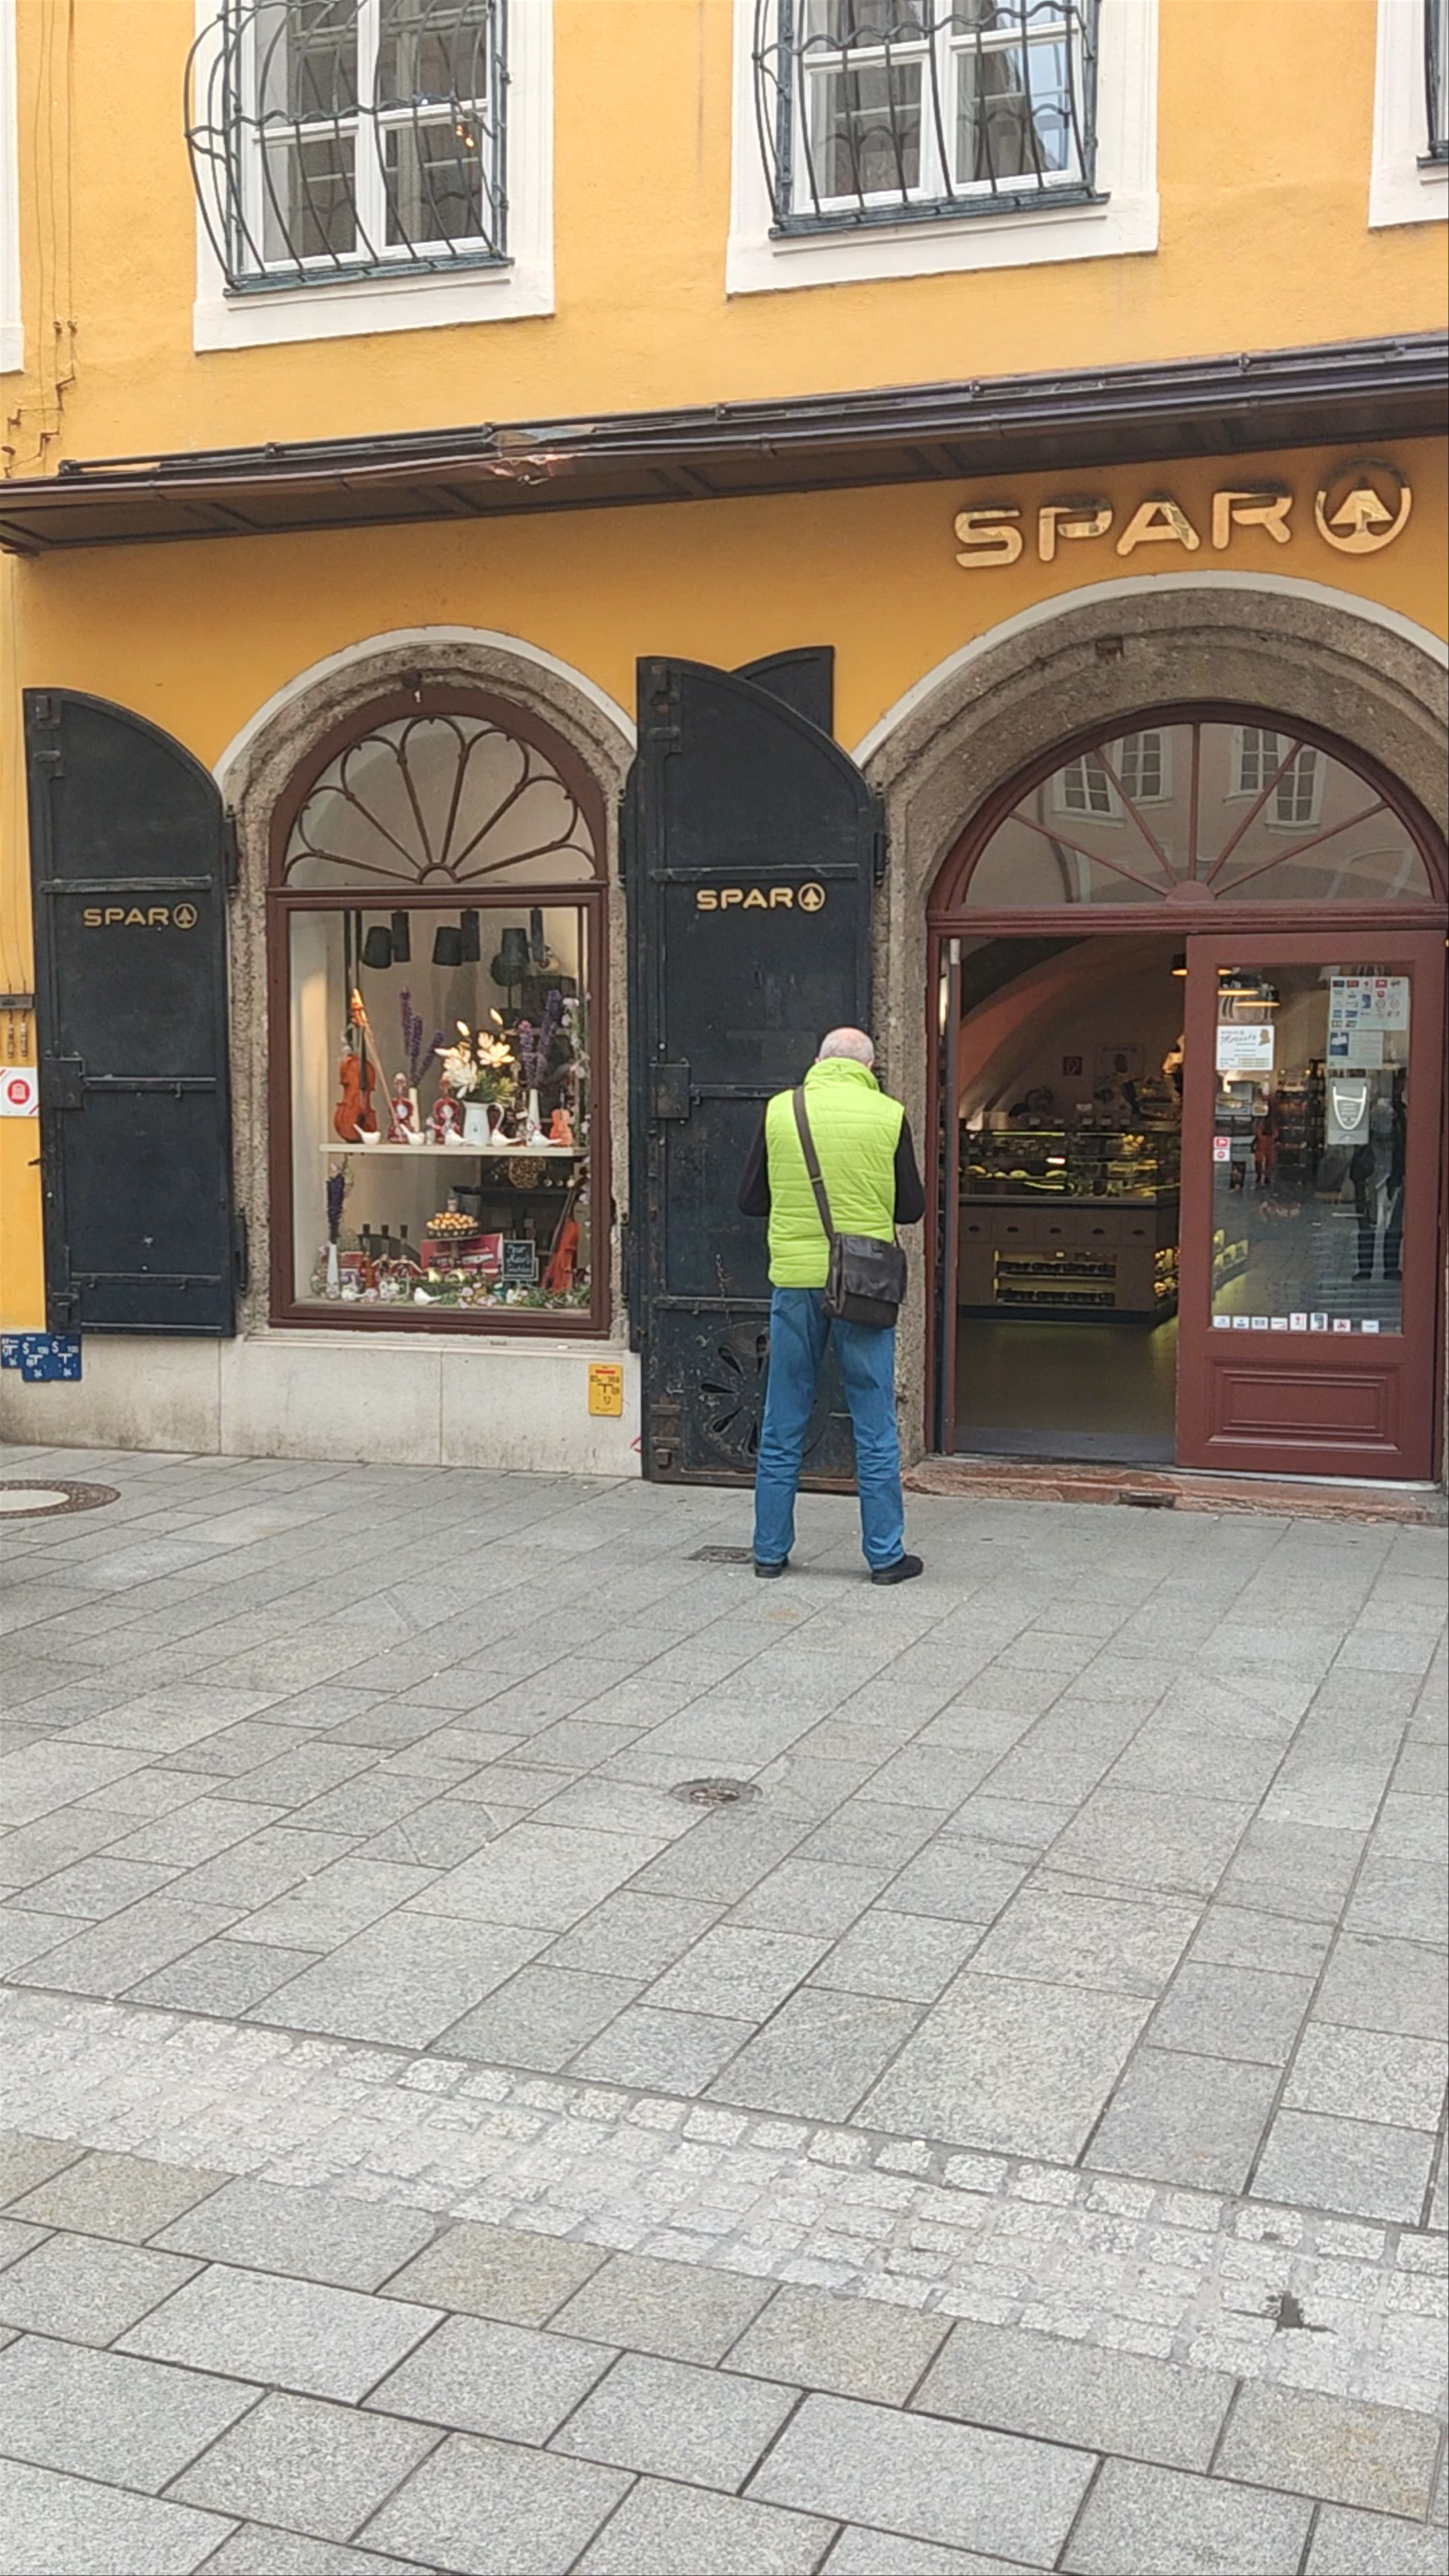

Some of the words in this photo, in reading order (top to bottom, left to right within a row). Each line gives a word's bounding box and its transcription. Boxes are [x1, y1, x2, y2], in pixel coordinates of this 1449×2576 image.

[954, 481, 1293, 568] SPAR
[697, 887, 793, 910] SPAR
[84, 907, 169, 926] SPAR
